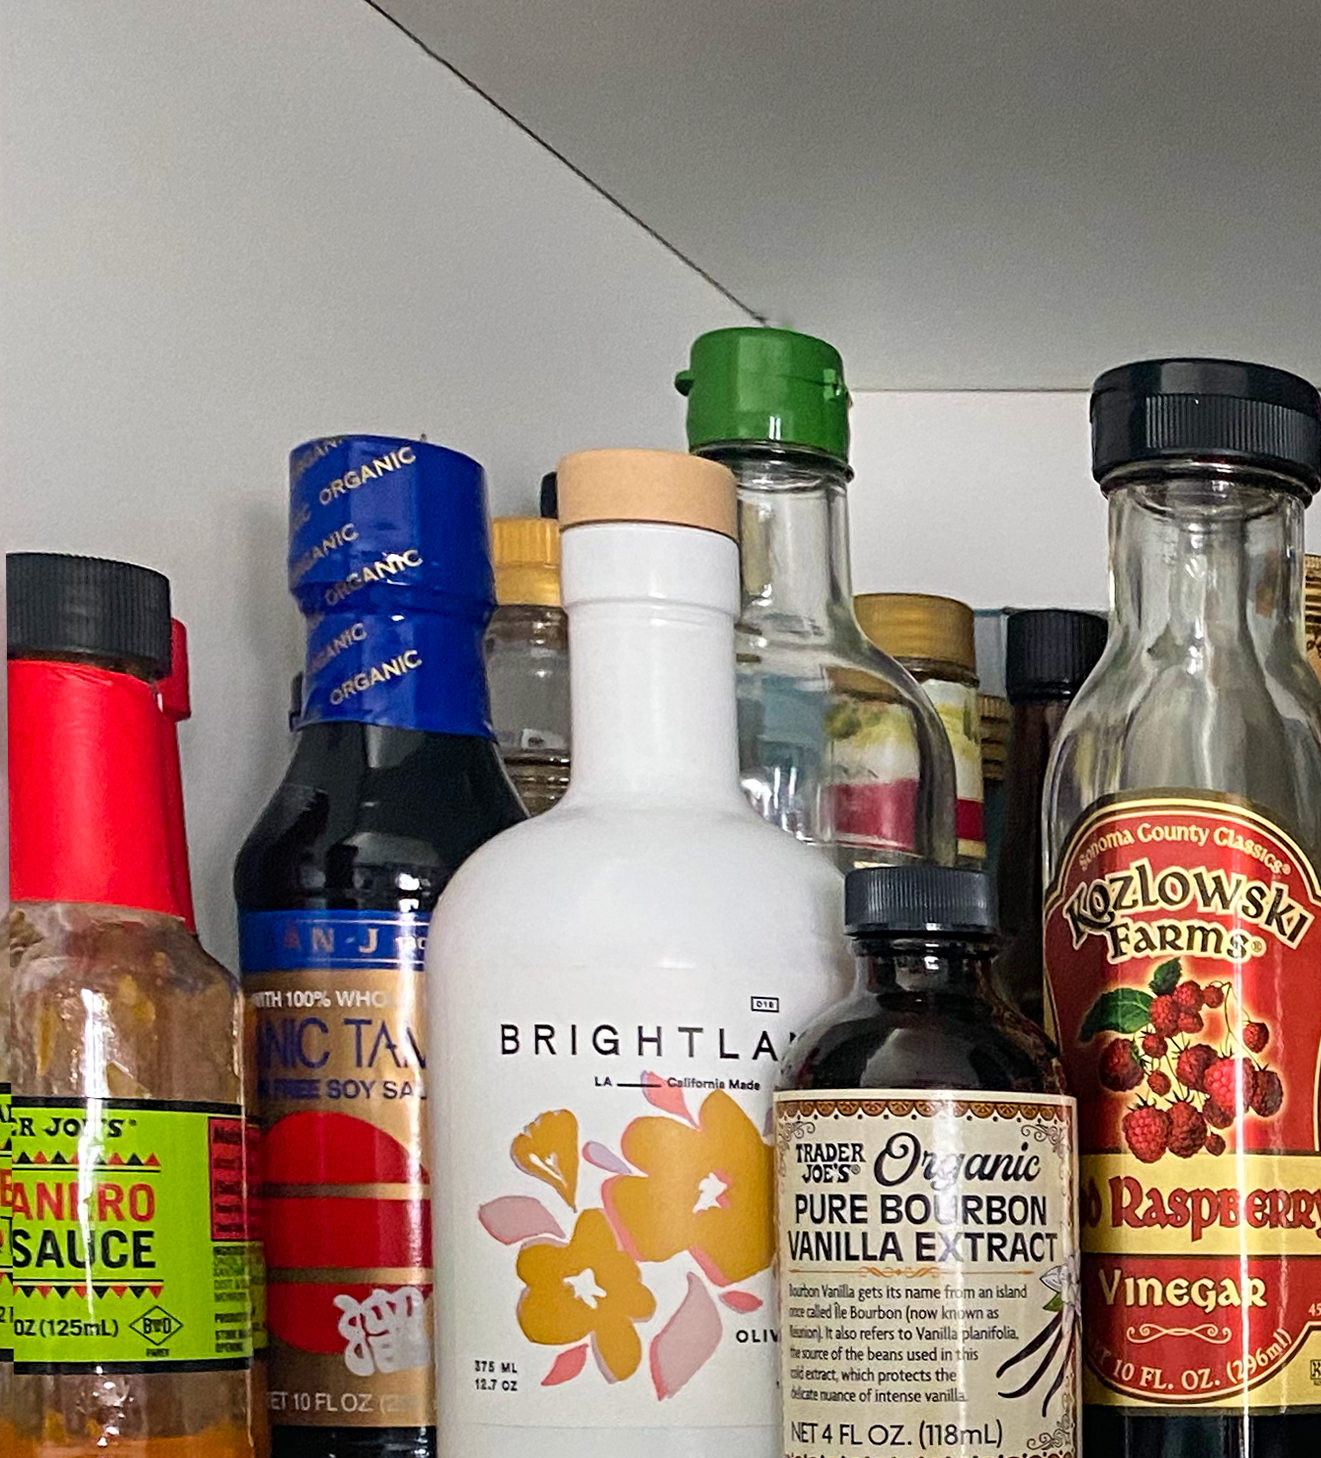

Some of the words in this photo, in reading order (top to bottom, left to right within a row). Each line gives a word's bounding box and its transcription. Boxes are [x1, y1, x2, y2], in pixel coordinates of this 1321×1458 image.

[318, 445, 418, 506] ORGANIC
[328, 650, 424, 706] ORGANIC
[1137, 824, 1209, 846] County
[594, 1077, 612, 1087] LA
[667, 1077, 726, 1090] California
[729, 1079, 760, 1091] Made
[796, 1143, 866, 1163] TRADER
[874, 1132, 1042, 1190] Organic
[795, 1194, 868, 1224] PURE
[881, 1195, 1047, 1225] BOURBON
[788, 1231, 903, 1262] VANILLA
[916, 1232, 1058, 1263] EXTRACT
[821, 1285, 855, 1299] Vanilla
[858, 1287, 882, 1300] gets
[886, 1286, 902, 1299] its
[905, 1288, 940, 1299] name
[944, 1286, 975, 1299] from
[978, 1288, 993, 1299] an
[996, 1284, 1027, 1299] island
[836, 1327, 857, 1340] also
[860, 1327, 895, 1341] refers
[898, 1329, 912, 1340] to
[916, 1327, 958, 1341] Vanilla
[830, 1347, 843, 1361] of
[845, 1348, 864, 1361] the
[868, 1348, 903, 1362] beans
[907, 1348, 937, 1362] used
[941, 1348, 953, 1361] in
[956, 1348, 979, 1362] this
[1114, 1357, 1134, 1380] 10
[1140, 1367, 1173, 1391] FL.
[1181, 1370, 1220, 1390] OZ.
[1227, 1329, 1292, 1383] (296ml)
